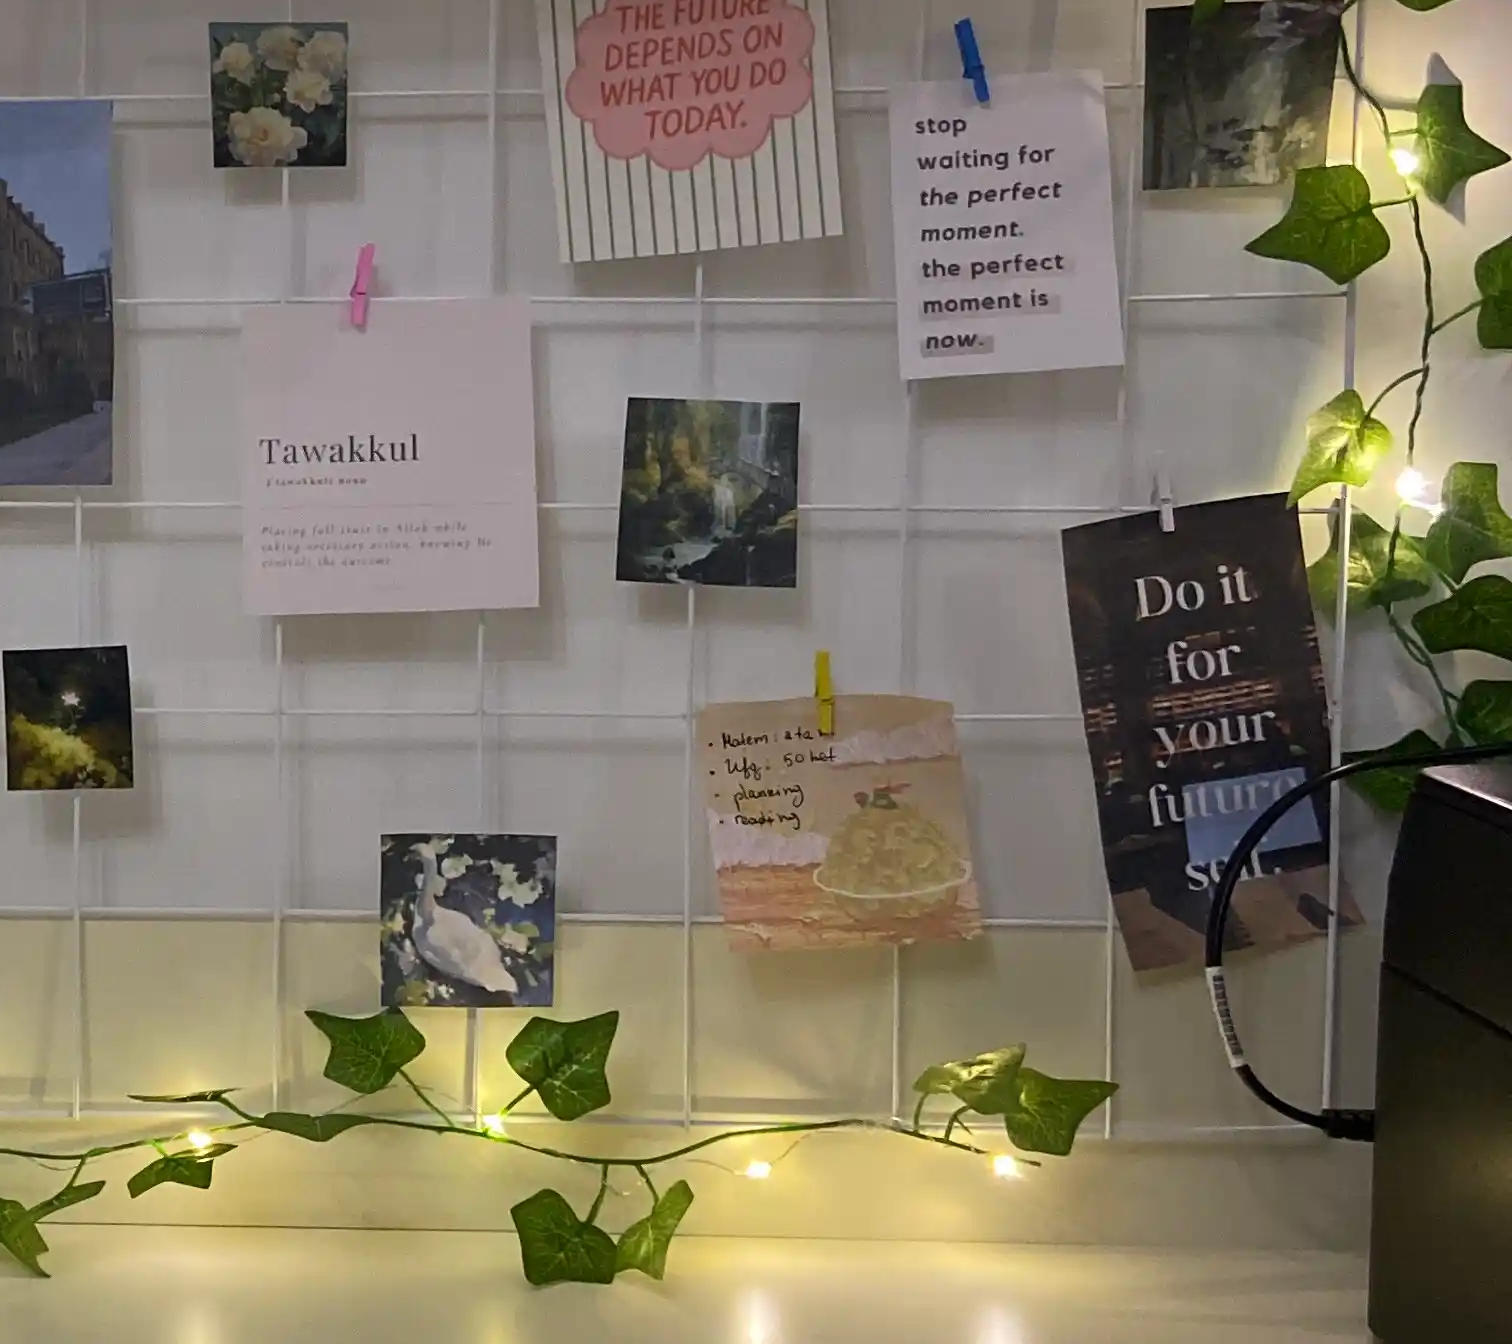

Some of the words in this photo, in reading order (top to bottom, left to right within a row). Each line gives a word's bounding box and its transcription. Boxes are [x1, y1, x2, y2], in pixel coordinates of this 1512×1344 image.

[616, 4, 665, 34] THE
[605, 28, 733, 73] DEPENDS
[743, 22, 784, 54] ON
[601, 72, 682, 108] WHAT
[690, 65, 740, 97] YOU
[749, 58, 787, 90] DO
[644, 100, 749, 141] TODAY.
[915, 118, 967, 137] stop
[917, 149, 1009, 170] waiting
[1018, 145, 1056, 165] for
[920, 188, 958, 207] the
[968, 182, 1063, 208] perfect
[921, 221, 1024, 242] moment.
[922, 259, 961, 278] the
[971, 254, 1064, 279] perfect
[923, 291, 1022, 314] moment
[1030, 289, 1049, 307] is
[926, 333, 986, 350] now.
[258, 433, 420, 465] Tawakkul
[1133, 574, 1204, 621] Do
[1217, 564, 1254, 605] it
[1165, 639, 1242, 685] for
[1153, 707, 1276, 769] your
[783, 752, 805, 767] 50
[1185, 835, 1282, 891] sef.
